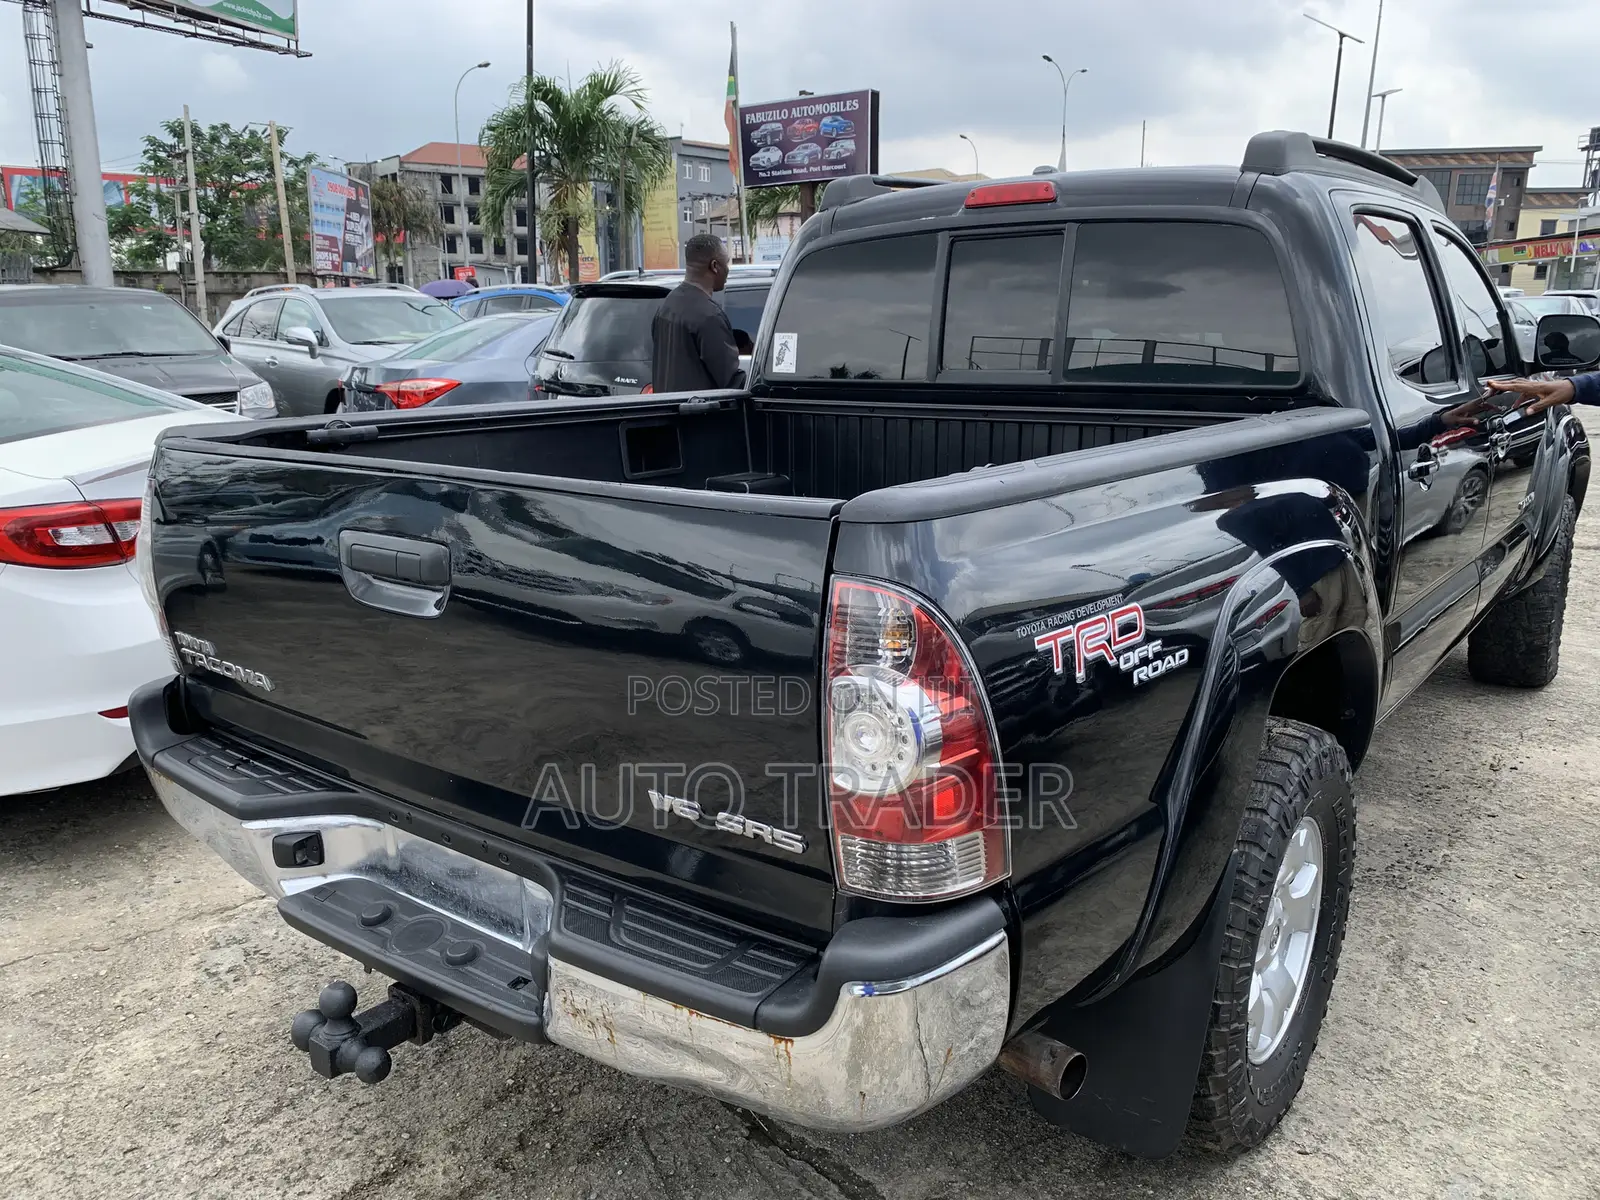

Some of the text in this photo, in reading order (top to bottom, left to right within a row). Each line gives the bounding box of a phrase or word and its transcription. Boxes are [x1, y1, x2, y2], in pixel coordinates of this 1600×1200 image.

[745, 99, 859, 124] FABUZILO AUTOMOBILES
[758, 170, 771, 178] No.2
[771, 168, 792, 177] Station
[809, 165, 821, 173] Port
[821, 163, 847, 172] Harcourt
[1016, 593, 1124, 639] TOYOTA RACING DEVELOPMENT
[1034, 602, 1145, 684] TRD
[1118, 639, 1163, 672] OFF
[180, 647, 276, 692] TACOMA
[1132, 648, 1189, 687] ROAD
[647, 789, 810, 855] V6 SR5
